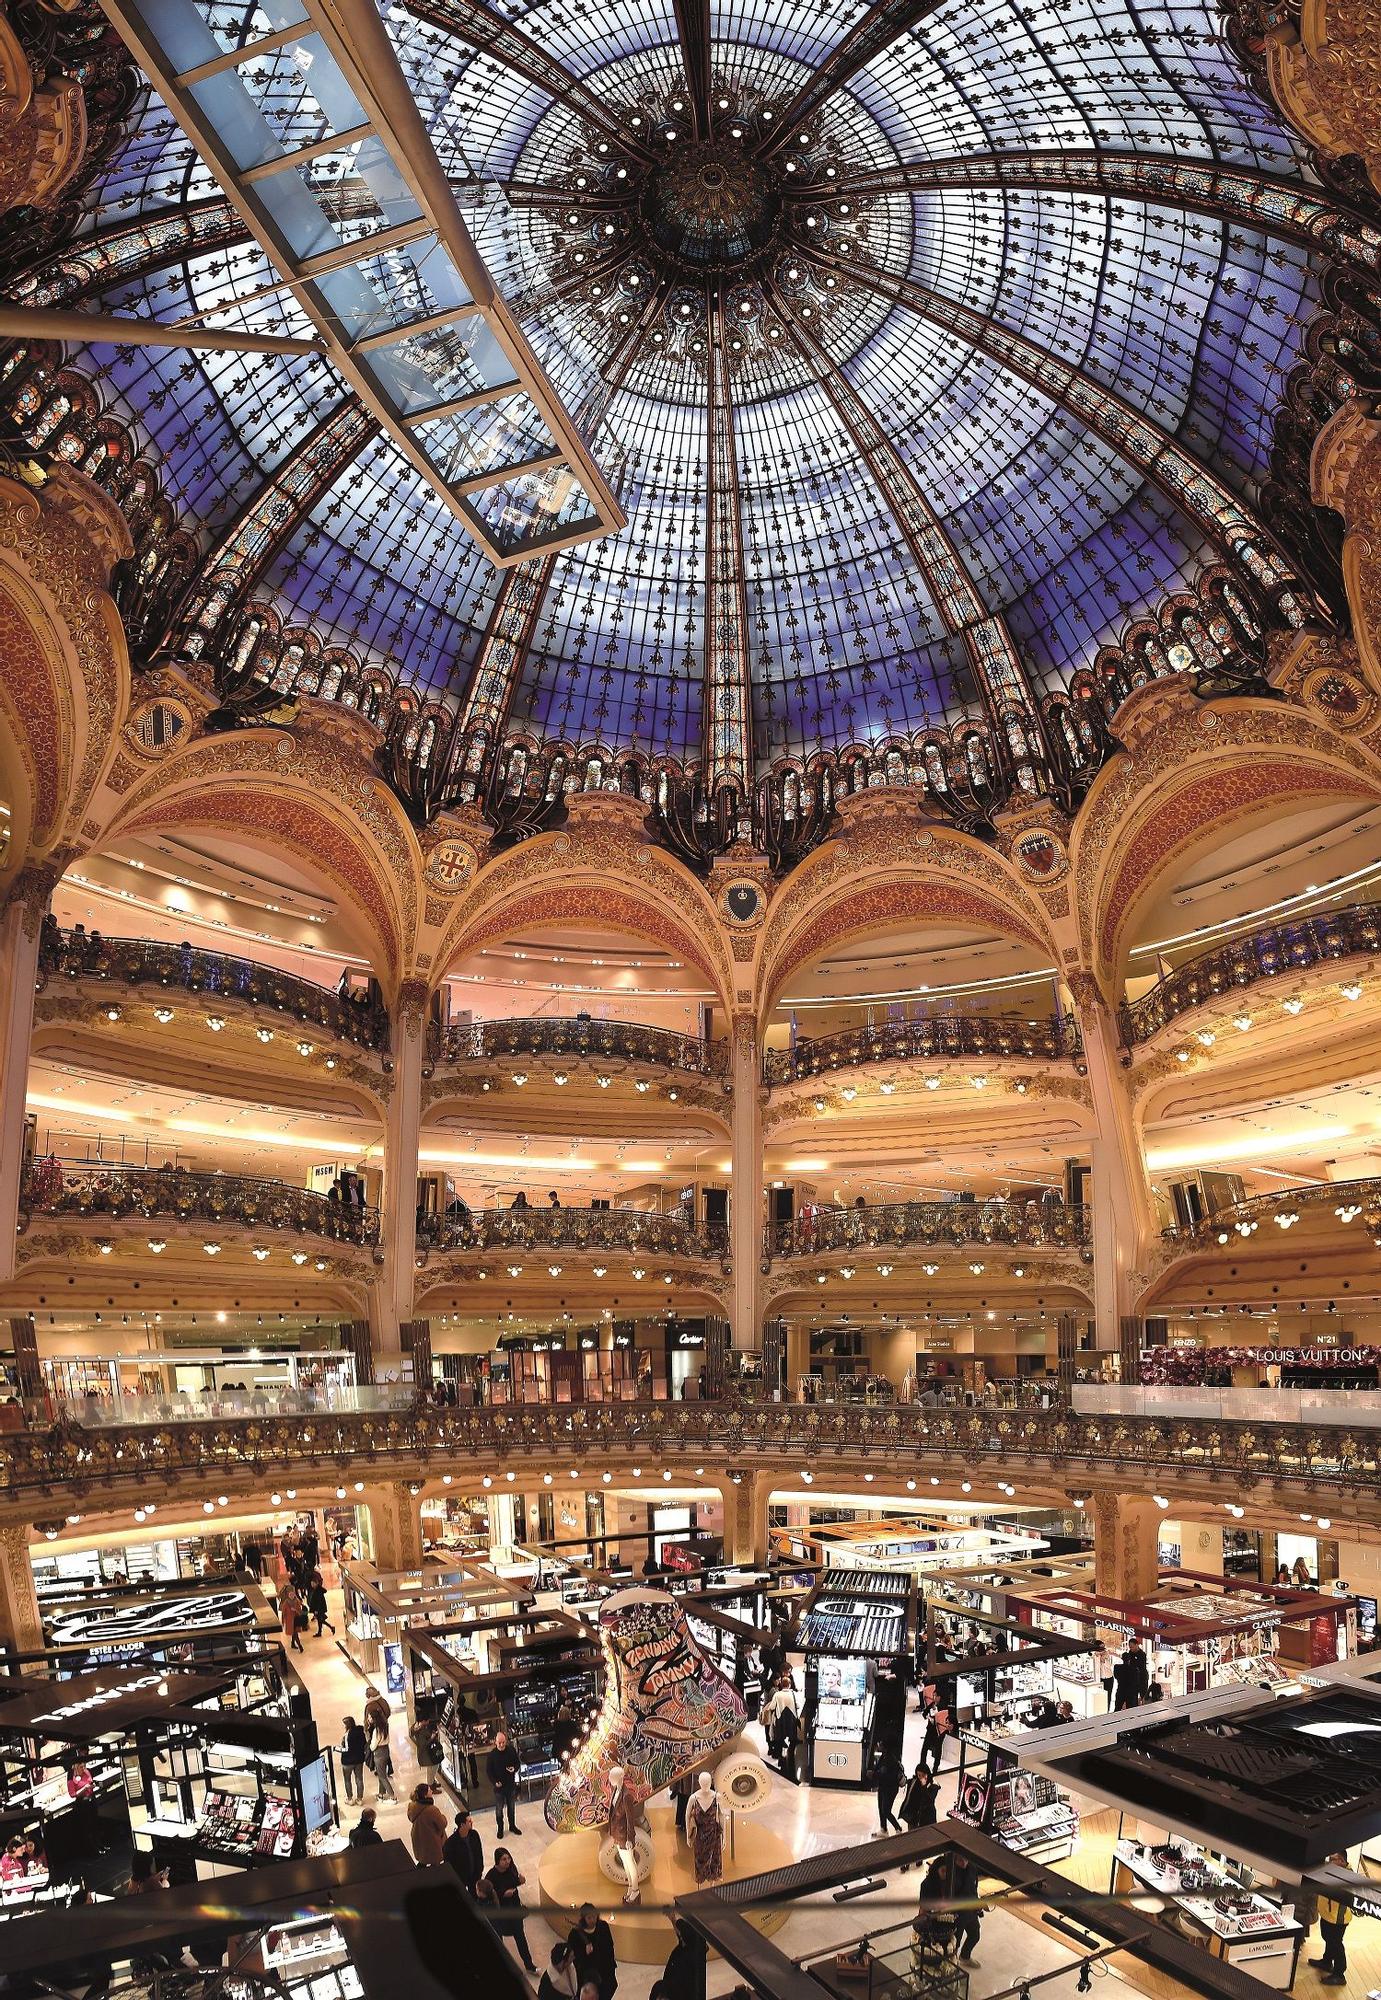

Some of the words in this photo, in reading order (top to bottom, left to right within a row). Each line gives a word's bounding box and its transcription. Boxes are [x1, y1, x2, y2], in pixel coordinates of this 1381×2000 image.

[1173, 1338, 1196, 1347] KENZO
[1256, 1350, 1294, 1362] LOUIS
[1300, 1350, 1362, 1362] VUITTON
[1094, 1619, 1136, 1637] CLARINS
[1252, 1618, 1282, 1630] CLARINS
[113, 1641, 145, 1654] LAUDER
[625, 1630, 682, 1670] ZENDAYA
[644, 1656, 696, 1696] TOMMY
[30, 1675, 162, 1724] CHANEL
